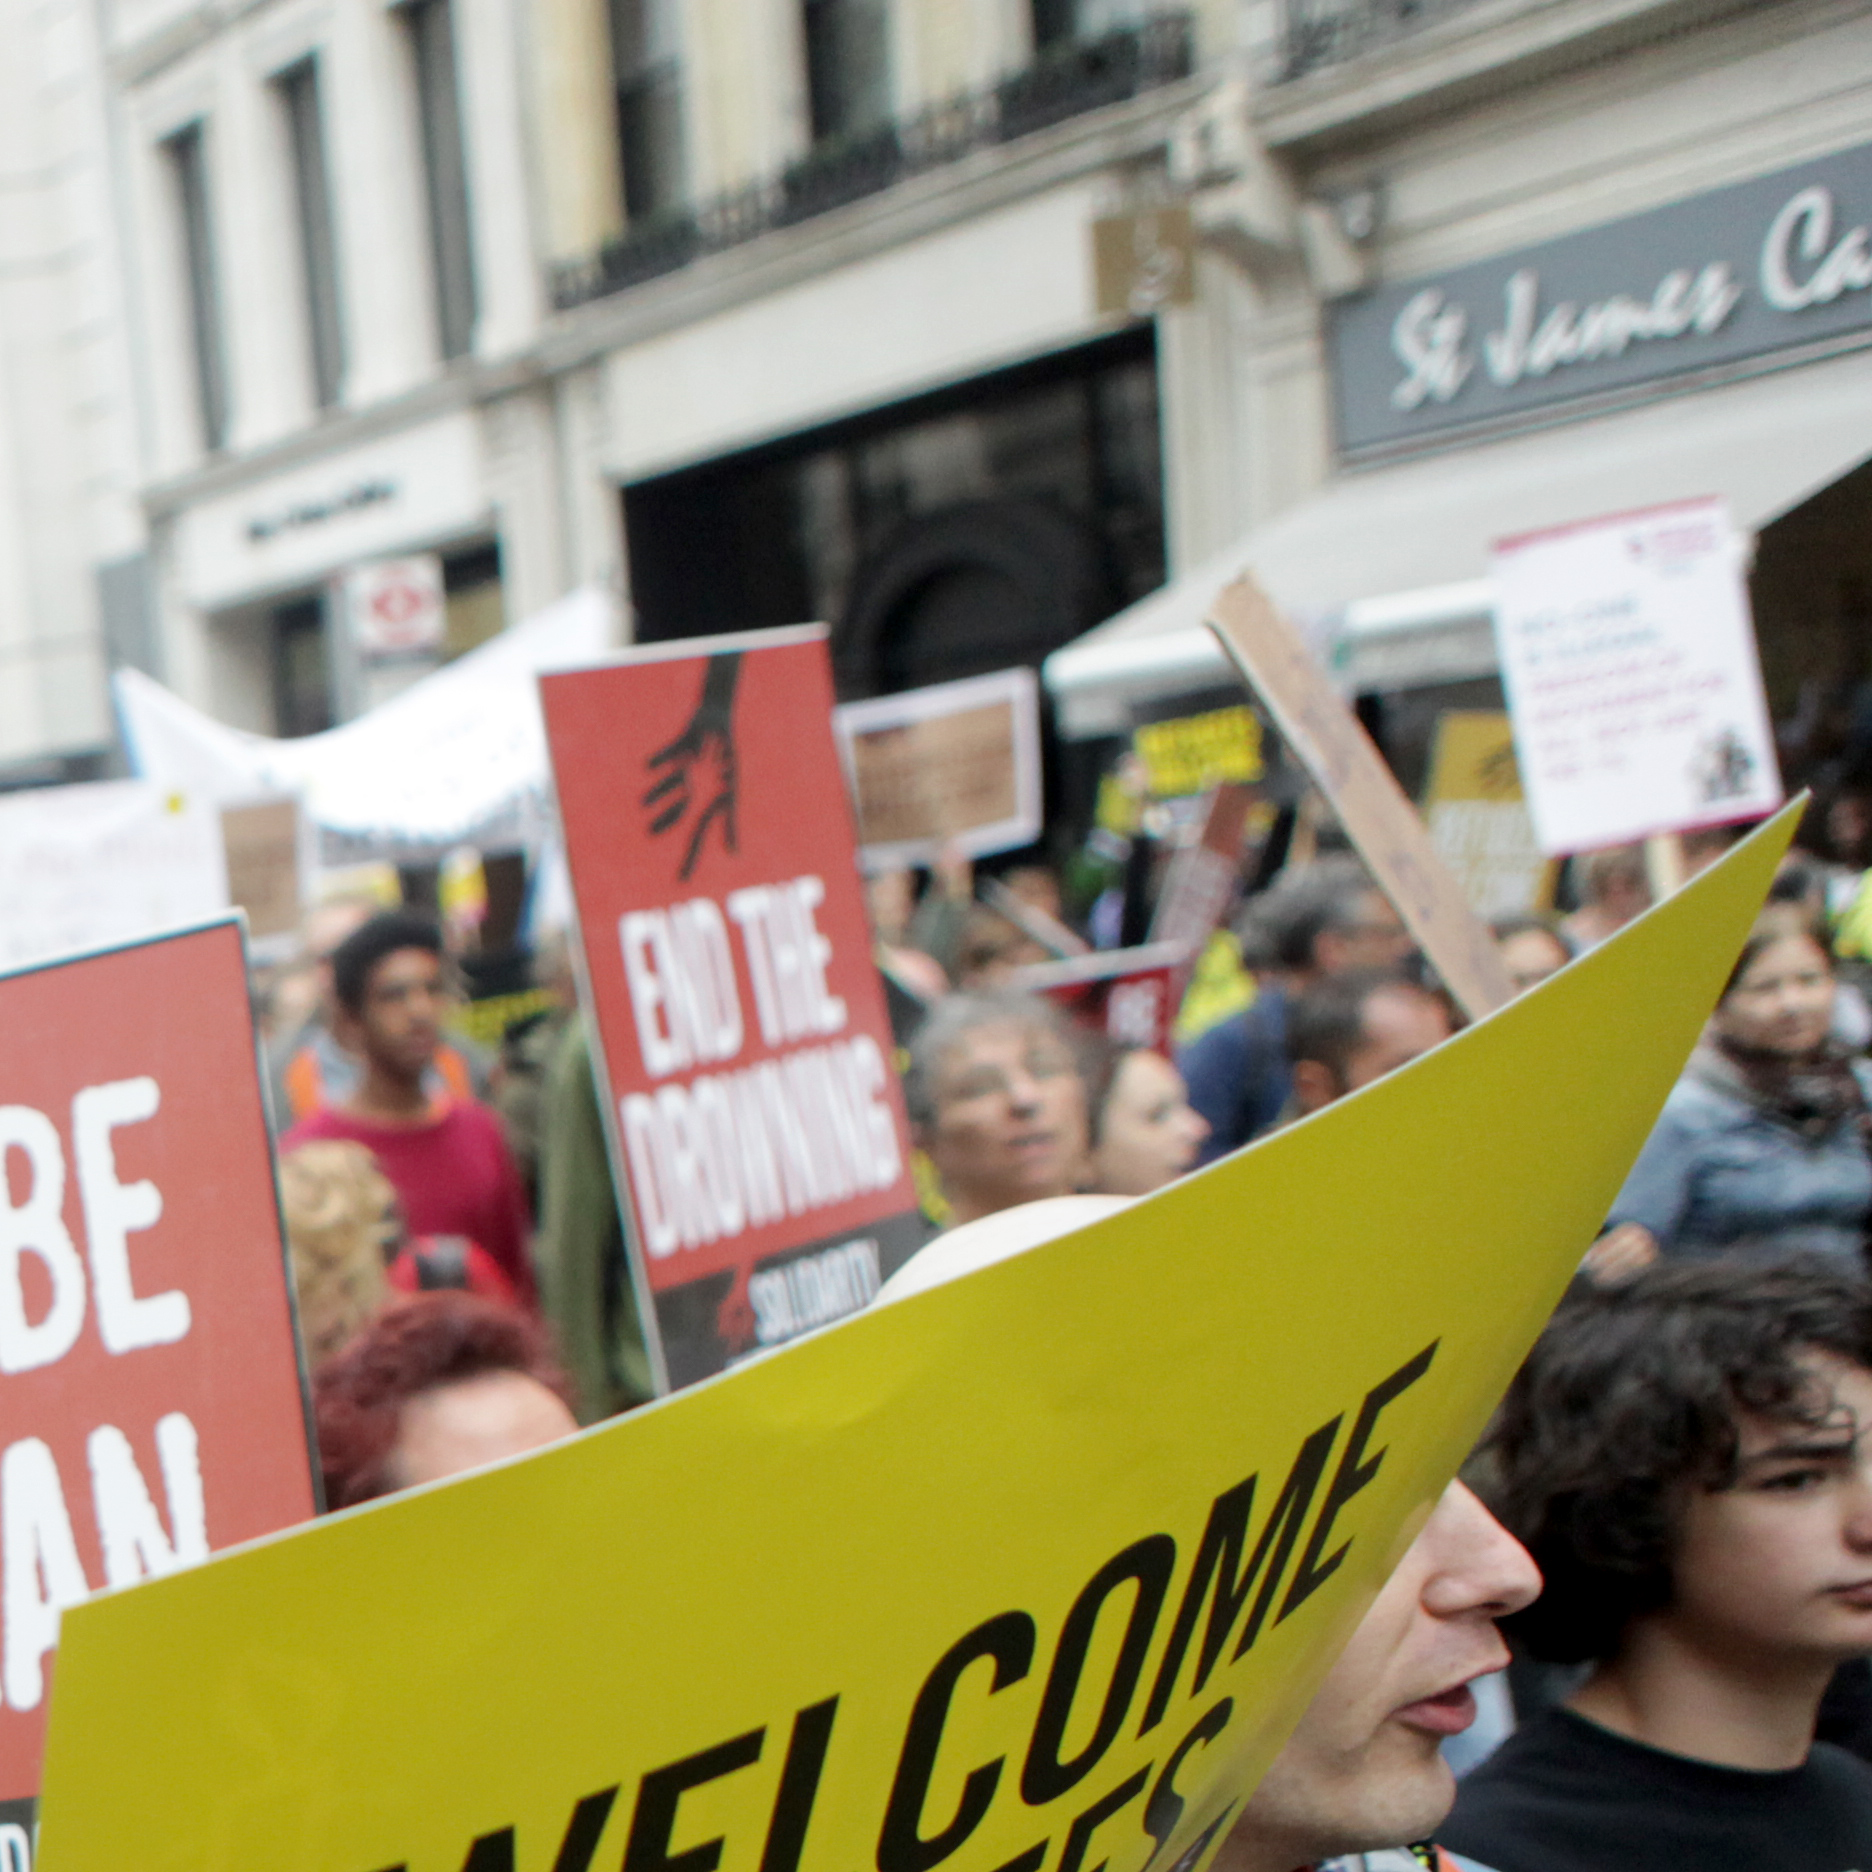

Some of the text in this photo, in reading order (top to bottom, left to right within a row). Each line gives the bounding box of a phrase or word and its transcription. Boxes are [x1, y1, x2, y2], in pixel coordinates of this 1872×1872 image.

[1391, 286, 1472, 411] St
[1485, 265, 1744, 386] James
[618, 875, 848, 1079] END THE
[620, 1033, 904, 1260] DROWNING
